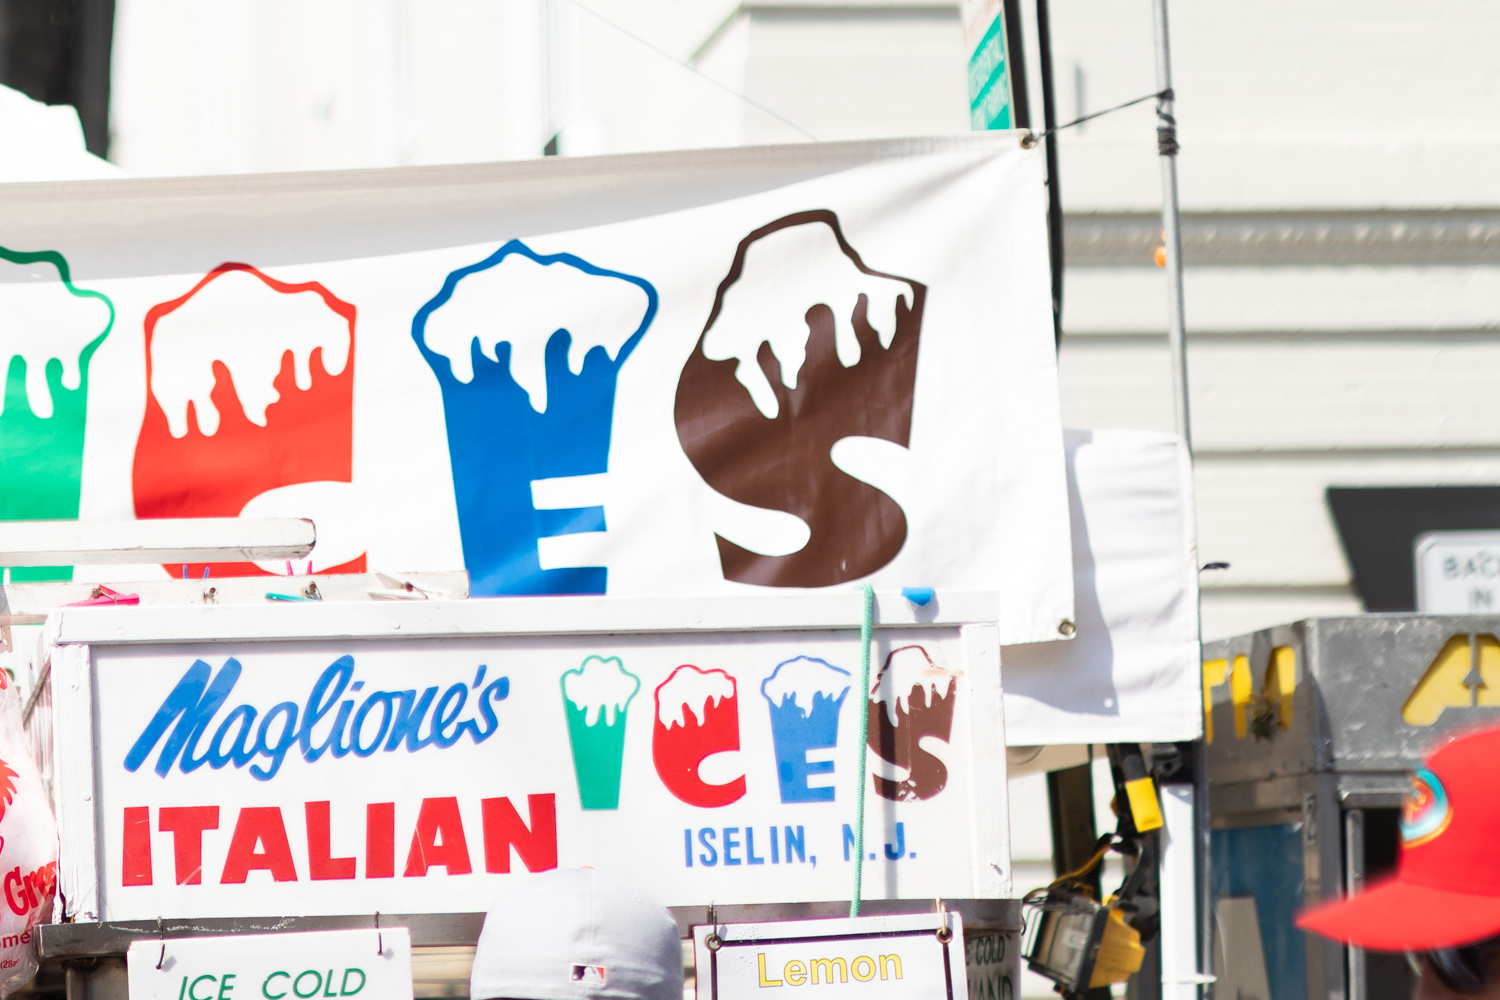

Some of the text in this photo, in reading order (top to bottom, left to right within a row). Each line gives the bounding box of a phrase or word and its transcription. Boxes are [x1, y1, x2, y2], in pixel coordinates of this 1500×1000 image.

[123, 654, 510, 781] Maglione's
[559, 644, 959, 812] ICES
[121, 792, 559, 887] ITALIAN
[684, 824, 819, 870] ISELIN,
[756, 953, 904, 988] Lemon
[974, 933, 1006, 967] COLD
[261, 967, 367, 1000] COLD
